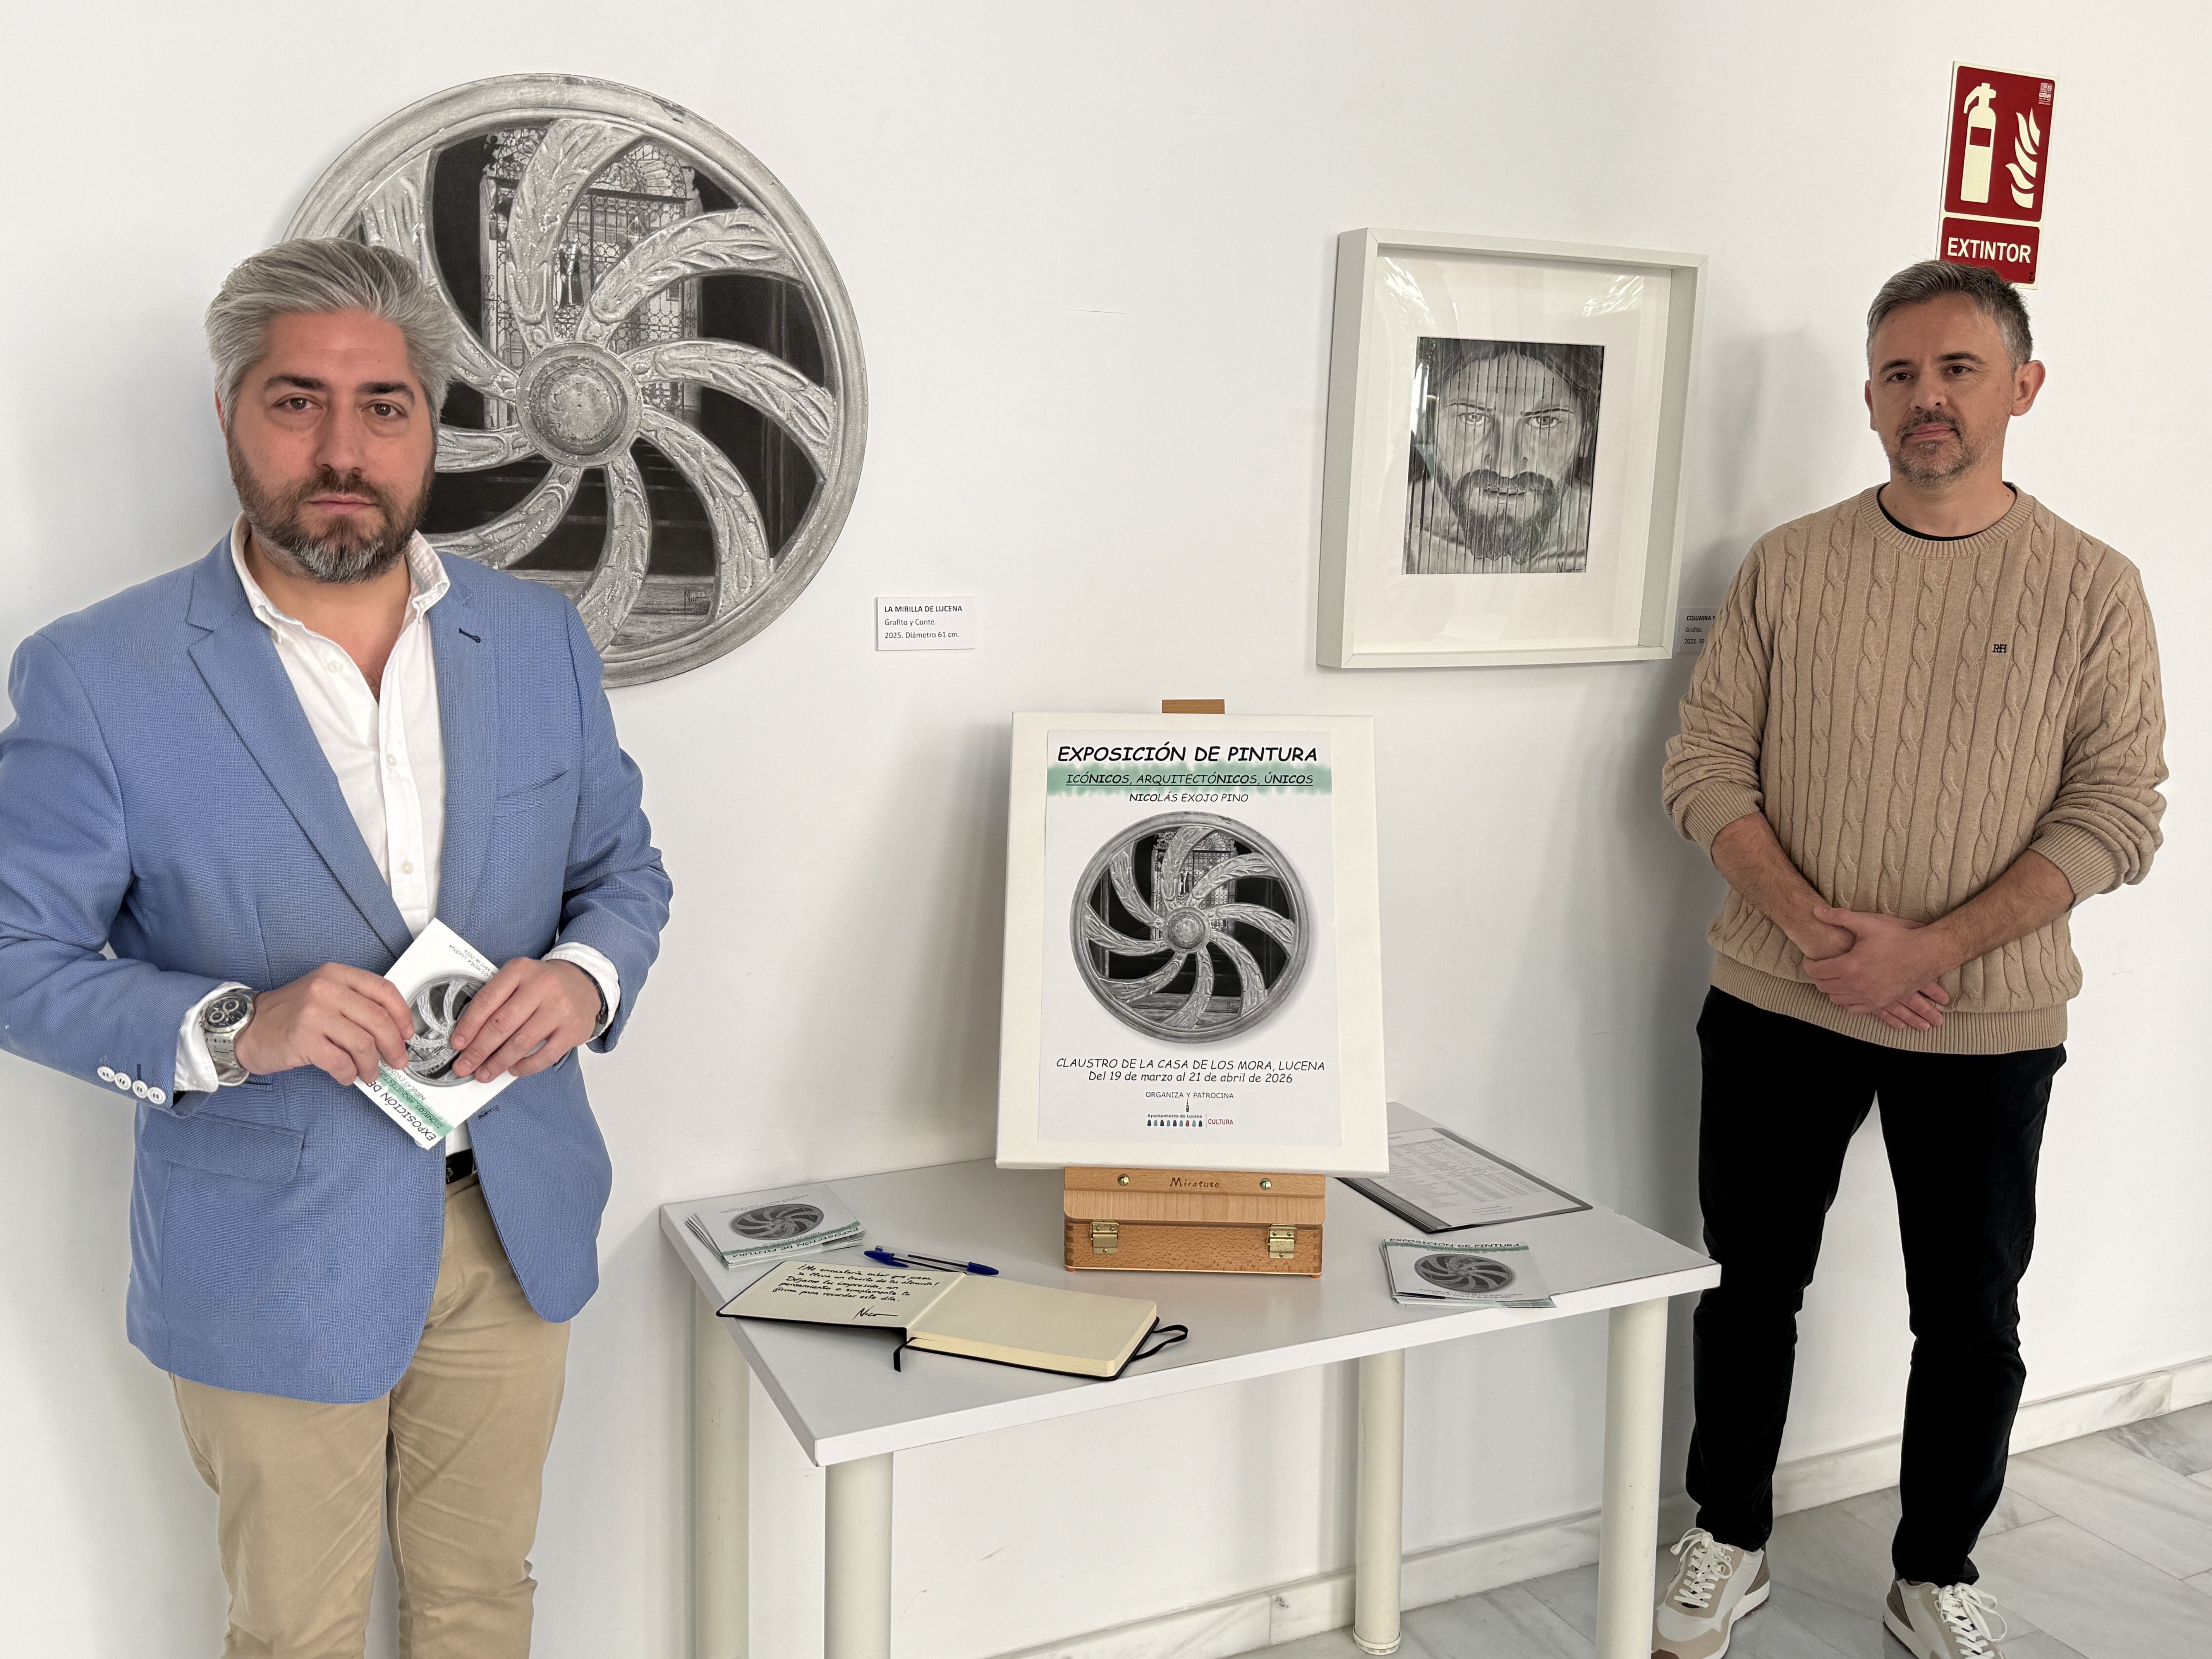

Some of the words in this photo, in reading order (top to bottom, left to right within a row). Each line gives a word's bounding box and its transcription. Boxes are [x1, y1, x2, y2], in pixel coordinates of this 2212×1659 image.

[1947, 237, 2031, 264] EXTINTOR
[1058, 741, 1186, 762] EXPOSICIÓN
[1194, 746, 1221, 762] DE
[1228, 746, 1317, 762] PINTURA
[1066, 771, 1132, 786] ICÓNICOS,
[1136, 771, 1261, 786] ARQUITECTÓNICOS,
[1264, 771, 1313, 784] ÚNICOS
[1129, 791, 1178, 802] NICOLÁS
[1181, 793, 1218, 802] EXOJO
[1221, 793, 1249, 802] PINO
[1056, 1058, 1118, 1068] CLAUSTRO
[1121, 1058, 1137, 1069] DE
[1140, 1059, 1154, 1069] LA
[1158, 1059, 1188, 1069] CASA
[1192, 1060, 1208, 1069] DE
[1211, 1060, 1234, 1070] LOS
[1238, 1060, 1276, 1072] MORA,
[1279, 1060, 1325, 1071] LUCENA
[1089, 1071, 1106, 1081] Del
[1109, 1071, 1121, 1081] 19
[1125, 1071, 1137, 1081] de
[1140, 1073, 1173, 1082] marzo
[1176, 1072, 1186, 1082] al
[1189, 1072, 1200, 1082] 21
[1204, 1072, 1217, 1082] de
[1220, 1072, 1245, 1082] abril
[1249, 1073, 1262, 1083] de
[1265, 1073, 1293, 1083] 2026
[380, 1092, 436, 1141] EXPOSICIÓN
